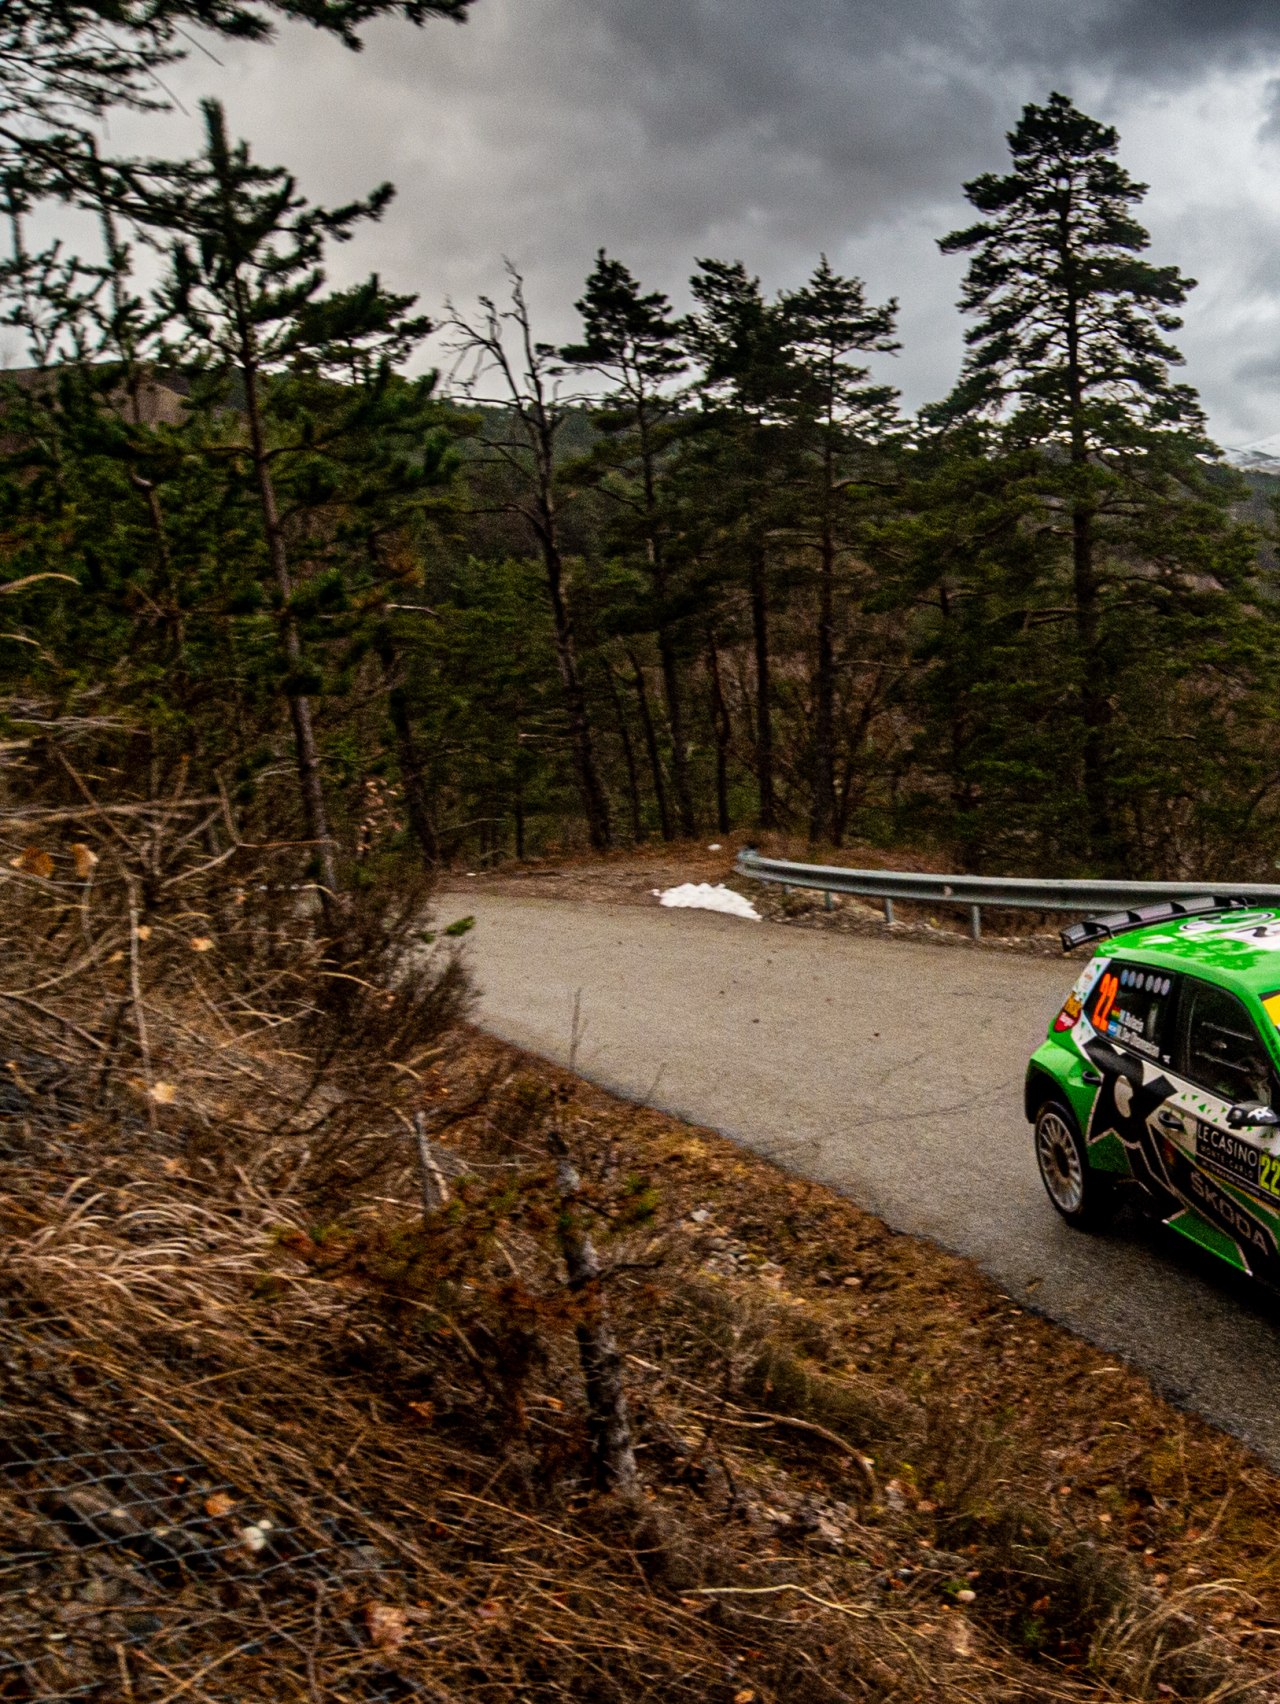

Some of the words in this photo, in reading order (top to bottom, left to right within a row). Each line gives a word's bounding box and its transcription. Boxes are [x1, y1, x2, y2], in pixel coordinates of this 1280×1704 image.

[1091, 972, 1119, 1032] 22
[1198, 1123, 1210, 1143] LE
[1210, 1130, 1258, 1167] CASINO
[1259, 1153, 1280, 1196] 22
